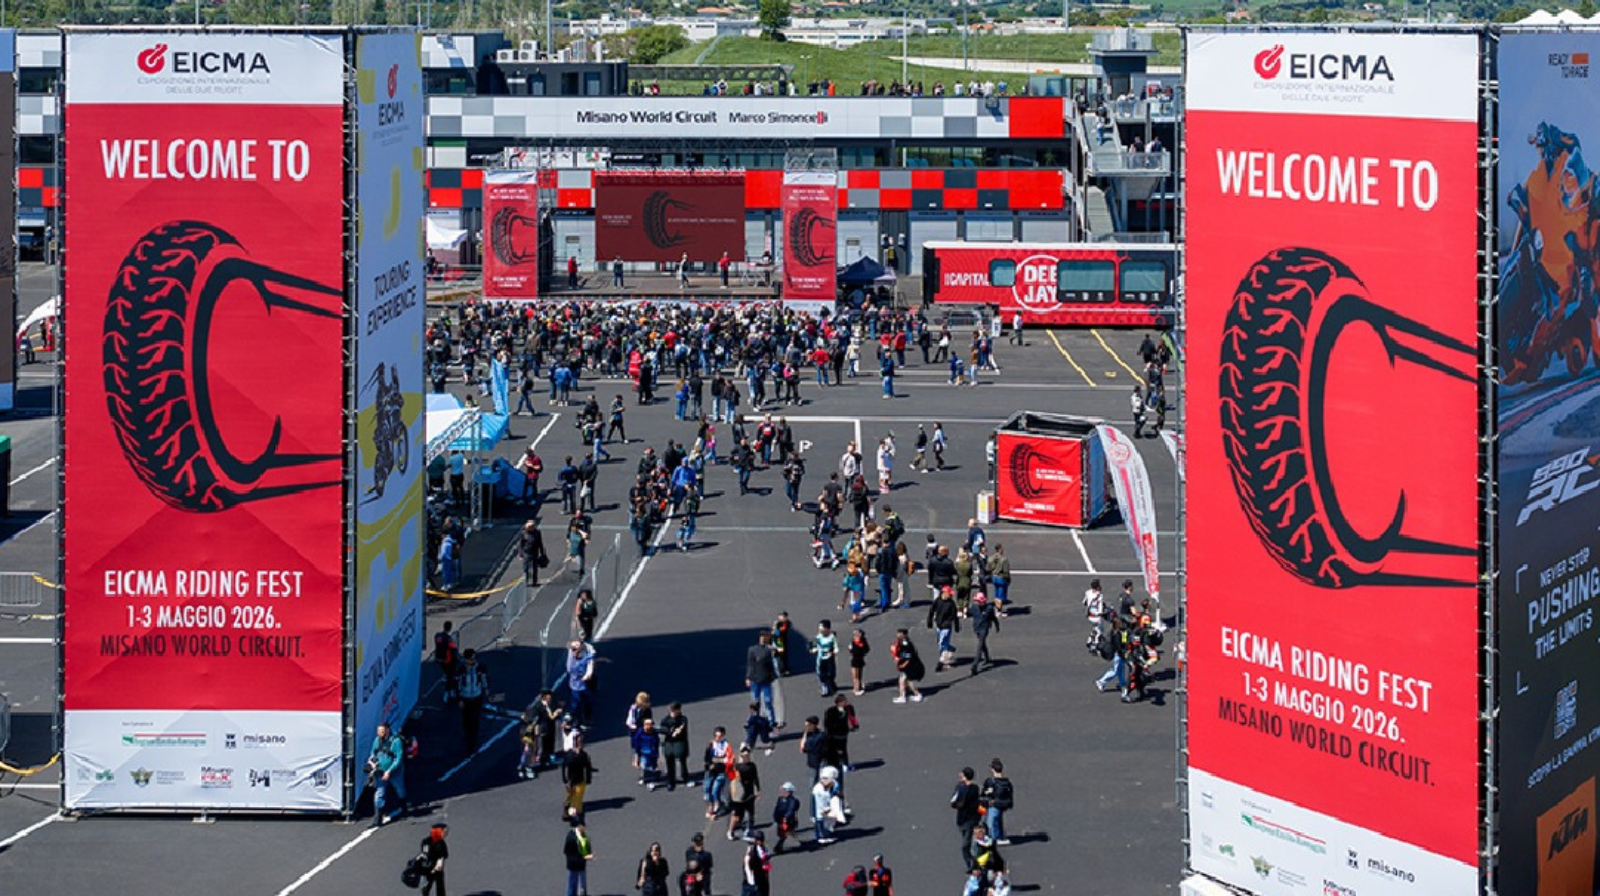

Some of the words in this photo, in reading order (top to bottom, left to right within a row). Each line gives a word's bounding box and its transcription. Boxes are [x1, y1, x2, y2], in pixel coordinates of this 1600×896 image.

[173, 52, 270, 73] EICMA
[1290, 54, 1395, 81] EICMA
[576, 110, 628, 123] Misano
[630, 110, 673, 123] World
[675, 110, 718, 123] Circuit
[728, 111, 766, 124] Marco
[100, 139, 257, 180] WELCOME
[267, 140, 310, 182] TO
[1216, 148, 1380, 206] WELCOME
[1389, 159, 1439, 211] TO
[105, 570, 168, 596] EICMA
[175, 570, 250, 598] RIDING
[256, 570, 304, 598] FEST
[1540, 559, 1567, 589] NEVER
[1568, 546, 1590, 573] STOP
[126, 605, 152, 628] 1-3
[156, 605, 226, 629] MAGGIO
[230, 605, 282, 629] 2026.
[1528, 566, 1600, 635] PUSHING
[100, 634, 167, 657] MISANO
[171, 634, 232, 657] WORLD
[238, 635, 306, 658] CIRCUIT.
[1535, 629, 1556, 660] THE
[1558, 607, 1594, 646] LIMITS
[1221, 626, 1284, 672] EICMA
[1291, 645, 1369, 695] RIDING
[1378, 670, 1432, 713] FEST
[1242, 672, 1268, 702] 1-3
[1273, 680, 1345, 724] MAGGIO
[1351, 704, 1406, 743] 2026.
[243, 733, 286, 744] misano
[1218, 696, 1283, 738] MISANO
[1289, 719, 1352, 759] WORLD
[1358, 740, 1436, 787] CIRCUIT.
[1548, 806, 1589, 862] KTM
[1367, 857, 1416, 884] misano
